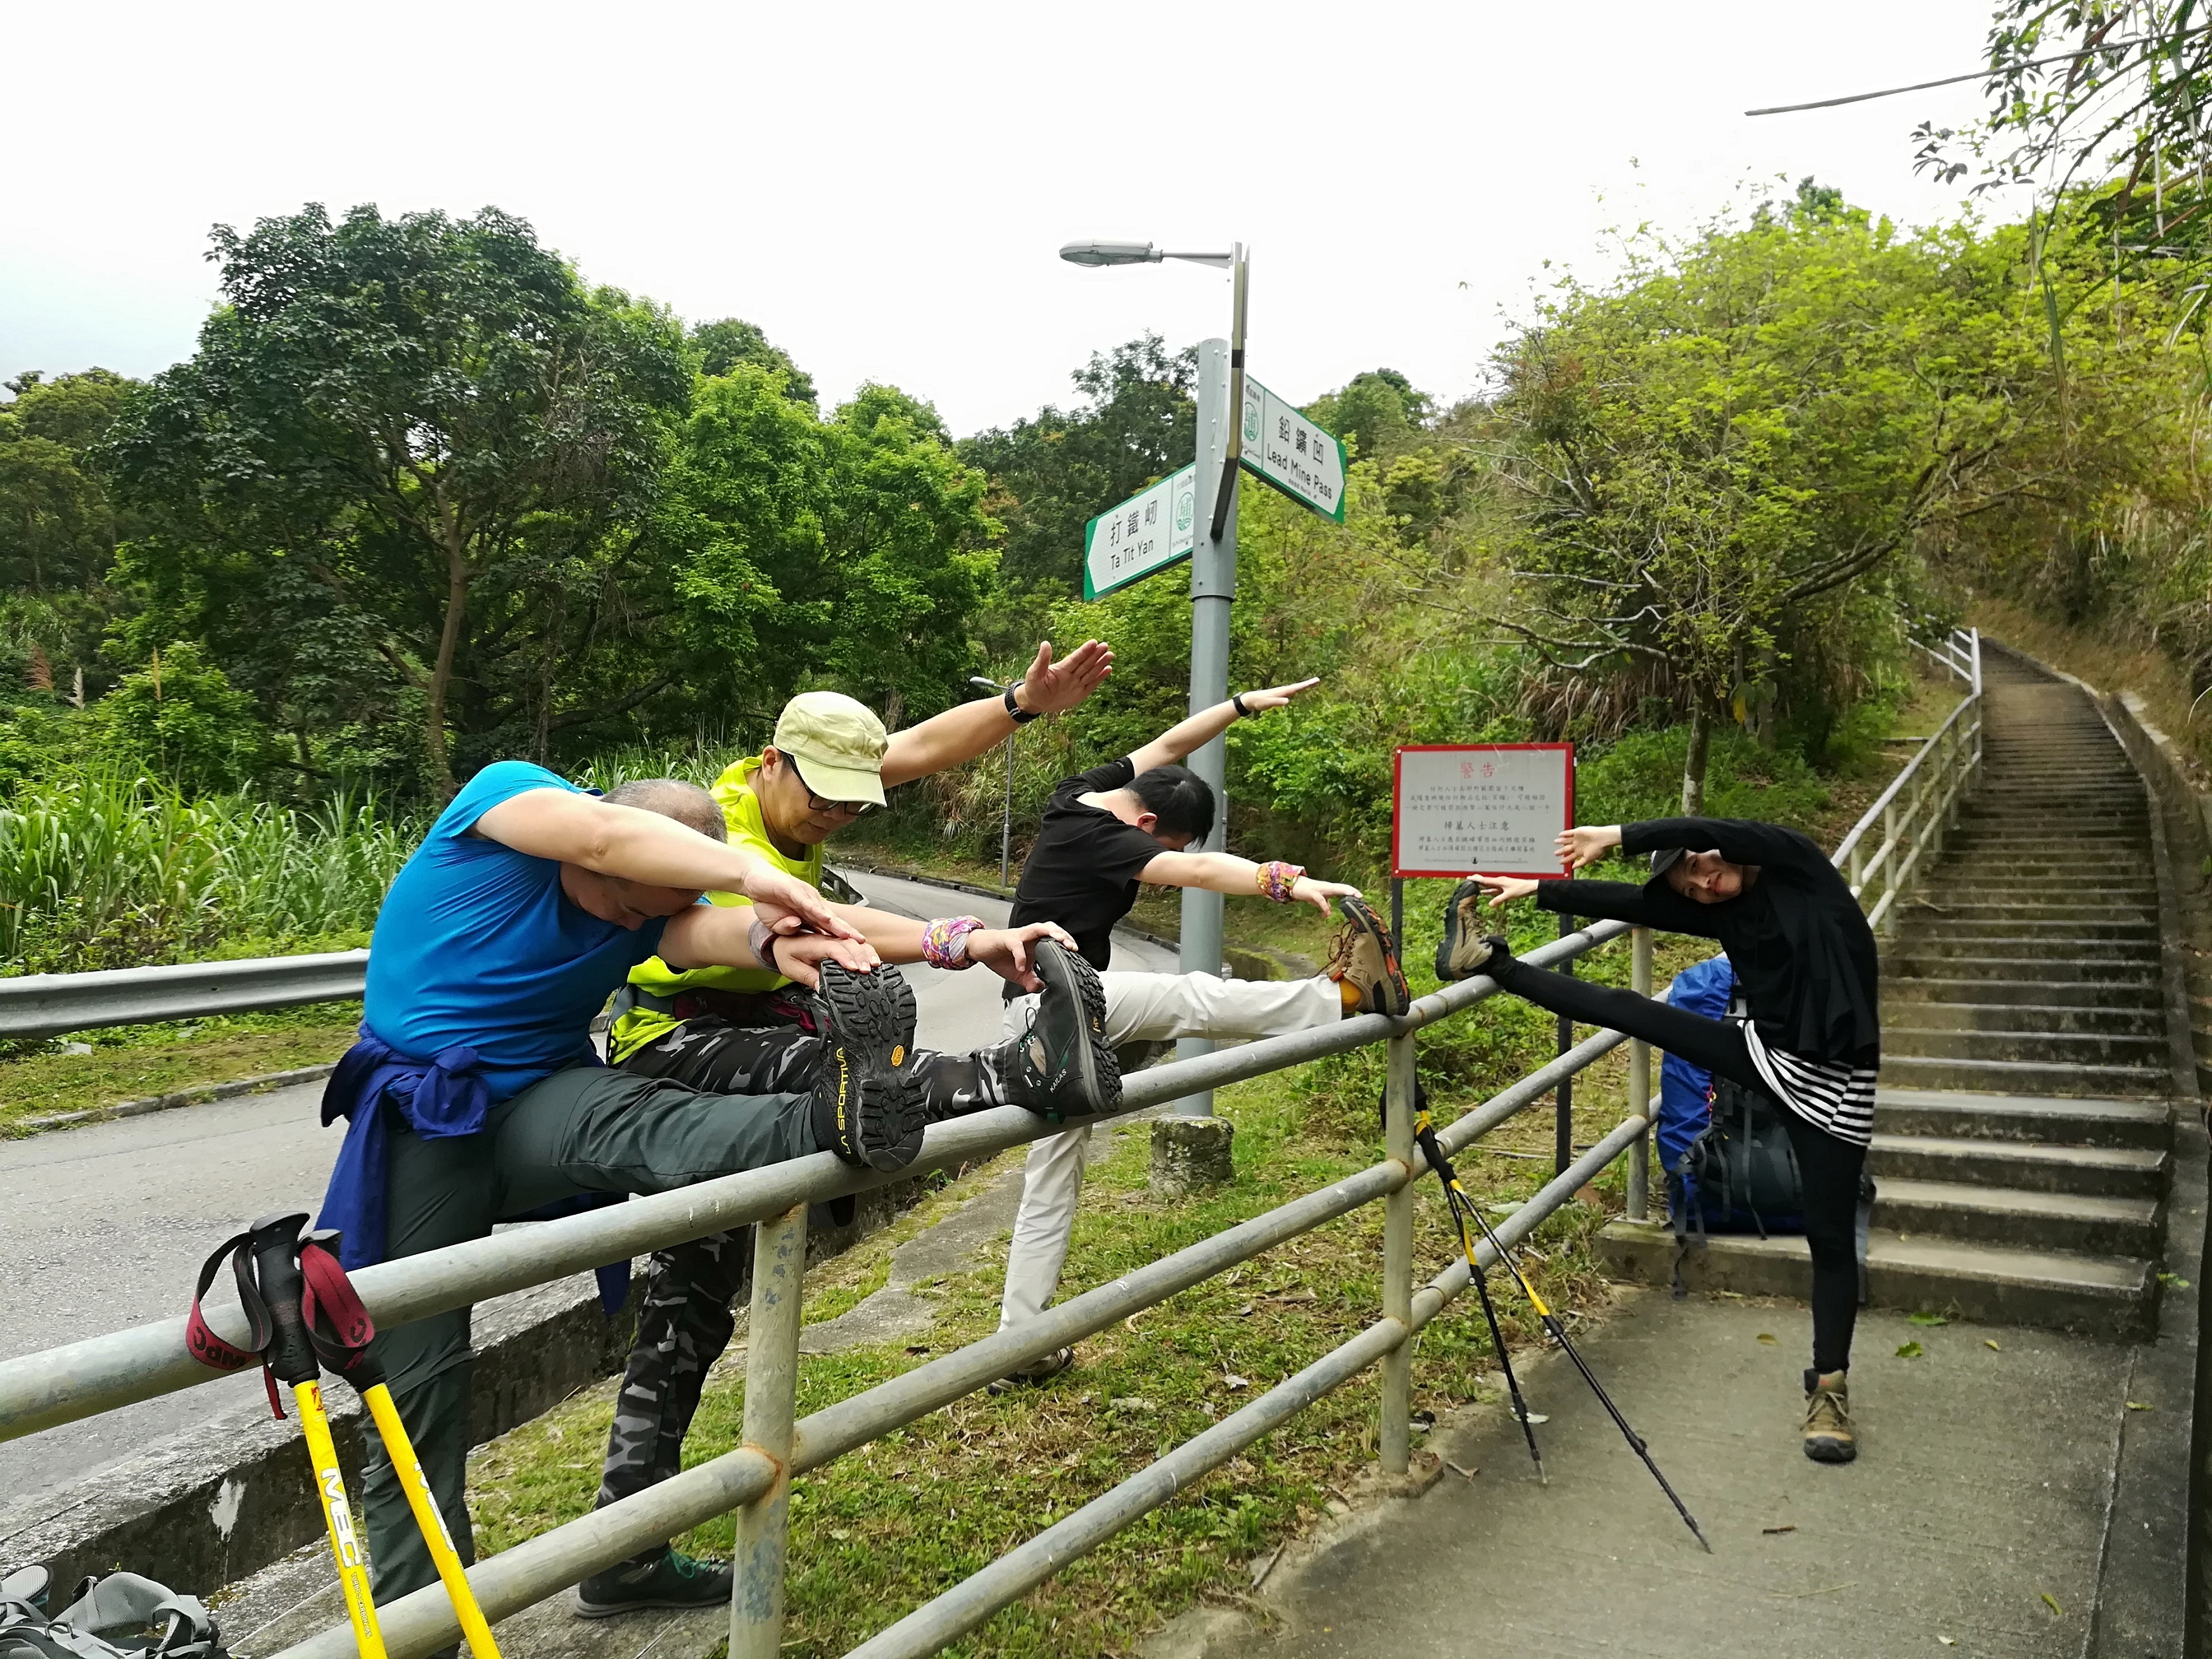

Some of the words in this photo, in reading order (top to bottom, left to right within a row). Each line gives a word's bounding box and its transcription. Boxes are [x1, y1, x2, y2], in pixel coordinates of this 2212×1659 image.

[1267, 443, 1287, 470] Lead
[1291, 459, 1311, 486] Mine
[1314, 474, 1332, 500] Pass
[1110, 554, 1120, 570] Ta
[1123, 545, 1134, 564] Tit
[1138, 540, 1153, 557] Yan
[1459, 761, 1495, 779] 警告
[836, 1047, 849, 1131] SPORTIVA
[1050, 1069, 1067, 1093] KAILAS
[841, 1135, 851, 1155] LA
[321, 1467, 362, 1568] MEC
[351, 1572, 361, 1594] TURBO
[357, 1599, 369, 1625] CARBON
